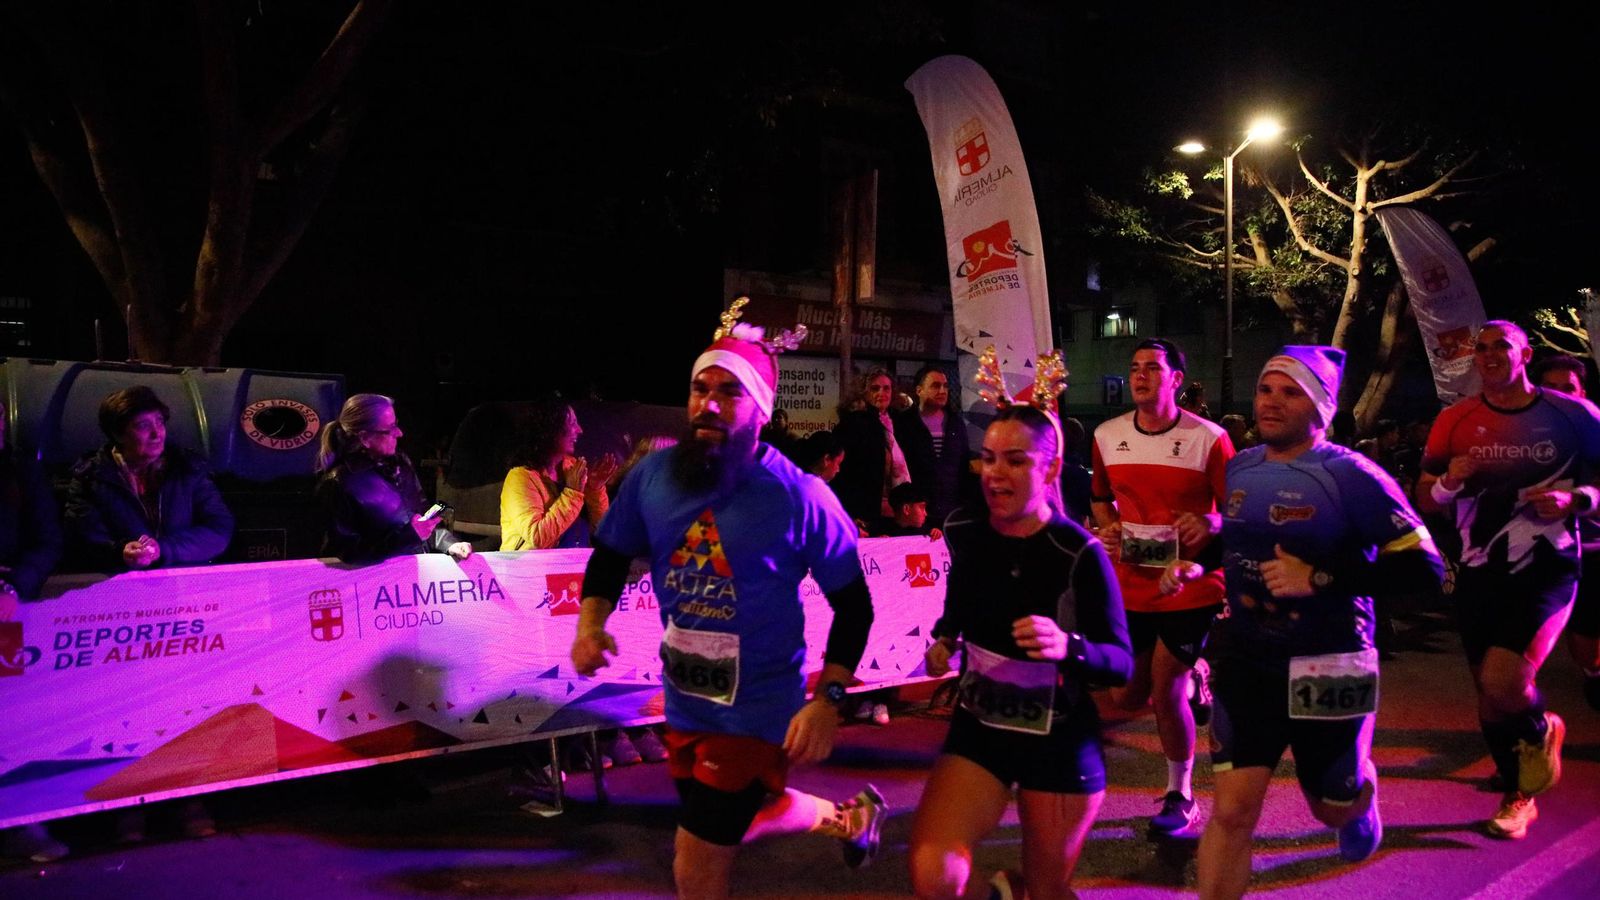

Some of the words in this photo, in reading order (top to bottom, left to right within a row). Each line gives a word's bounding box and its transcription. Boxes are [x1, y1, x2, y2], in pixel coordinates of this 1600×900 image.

[858, 311, 892, 331] Más
[778, 368, 825, 381] ensando
[775, 382, 810, 396] ender
[813, 383, 825, 396] tu
[242, 402, 266, 421] SOLO
[271, 400, 318, 423] ENVASES
[788, 421, 826, 433] onsigue
[250, 430, 264, 443] DE
[270, 430, 314, 449] VIDRIO
[373, 573, 505, 610] ALMERÍA
[664, 569, 738, 602] ALTEA
[53, 610, 130, 625] PATRONATO
[135, 604, 200, 618] MUNICIPAL
[204, 603, 219, 612] DE
[373, 610, 445, 632] CIUDAD
[53, 619, 205, 651] DEPORTES
[53, 650, 94, 670] DE
[102, 633, 225, 664] ALMERIA
[1297, 683, 1372, 709] 1467
